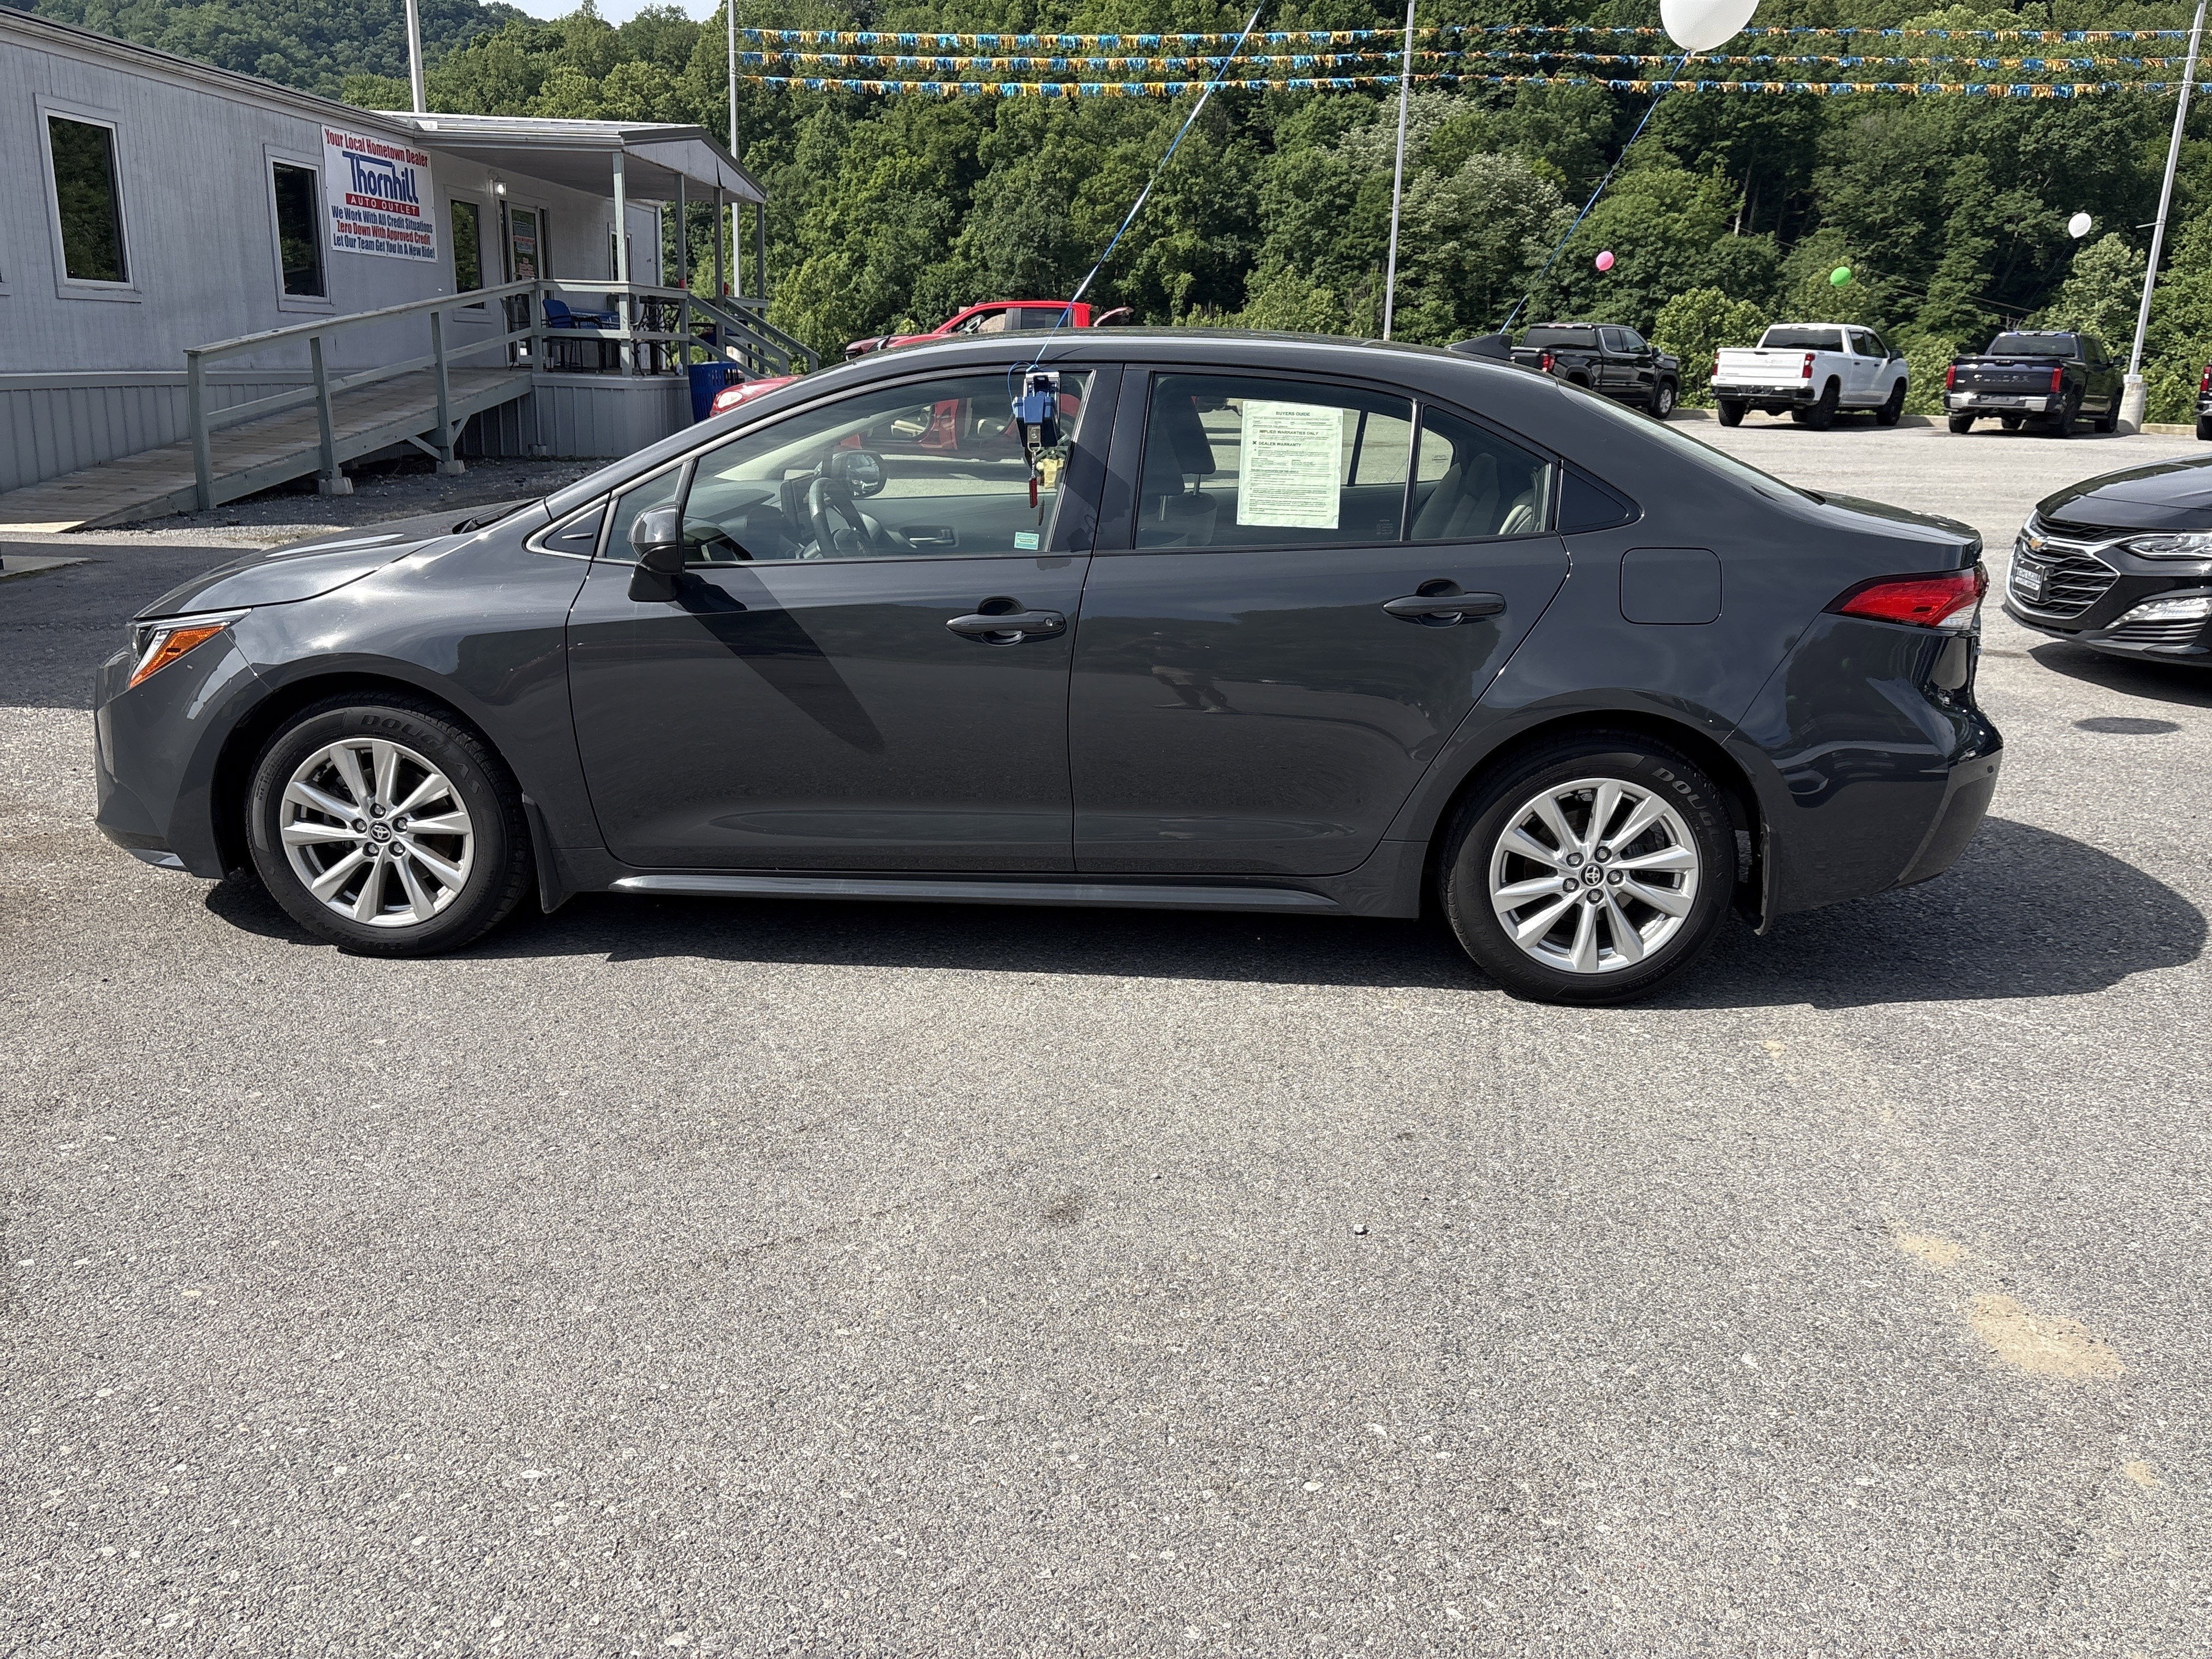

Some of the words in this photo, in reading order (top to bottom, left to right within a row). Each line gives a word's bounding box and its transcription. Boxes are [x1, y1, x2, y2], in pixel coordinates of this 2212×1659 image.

[324, 128, 343, 147] Your
[345, 133, 366, 153] Local
[366, 139, 405, 162] Hometown
[405, 148, 428, 167] Dealer
[342, 150, 419, 204] Thornhill
[331, 205, 343, 219] We
[344, 207, 362, 222] Work
[363, 210, 377, 224] With
[387, 215, 404, 229] Credit
[405, 217, 433, 234] Situations
[351, 195, 377, 208] AUTO
[381, 201, 415, 215] OUTLET
[334, 233, 344, 247] Let
[345, 235, 357, 248] Our
[357, 236, 375, 250] Team
[375, 239, 385, 252] Get
[386, 240, 397, 253] You
[397, 242, 403, 254] In
[404, 243, 408, 255] A
[409, 244, 421, 256] New
[422, 246, 435, 258] Ride!
[337, 219, 352, 234] Zero
[353, 222, 371, 236] Down
[371, 225, 386, 238] With
[387, 227, 414, 242] Approved
[414, 232, 431, 245] Credit
[360, 714, 486, 795] DOUGLAS
